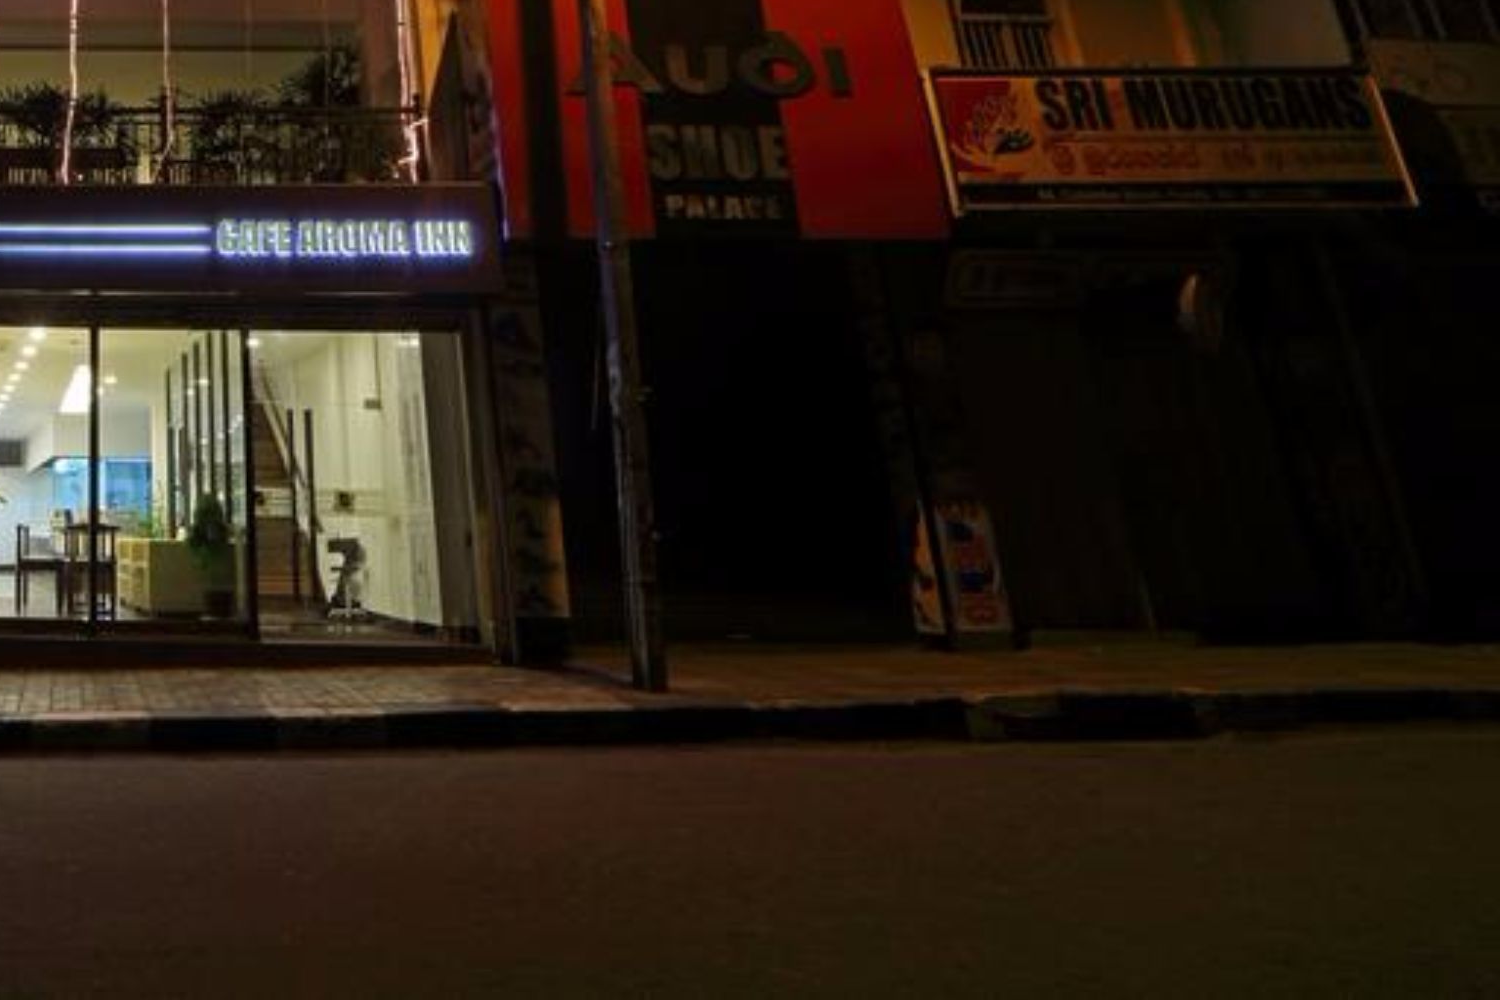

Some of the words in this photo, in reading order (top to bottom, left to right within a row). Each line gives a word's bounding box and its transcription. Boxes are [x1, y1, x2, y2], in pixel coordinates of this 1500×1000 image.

[1034, 77, 1115, 131] SRI
[1121, 77, 1371, 131] MURUGANS
[216, 217, 291, 256] CAFE
[296, 219, 411, 257] AROMA
[414, 220, 472, 256] INN
